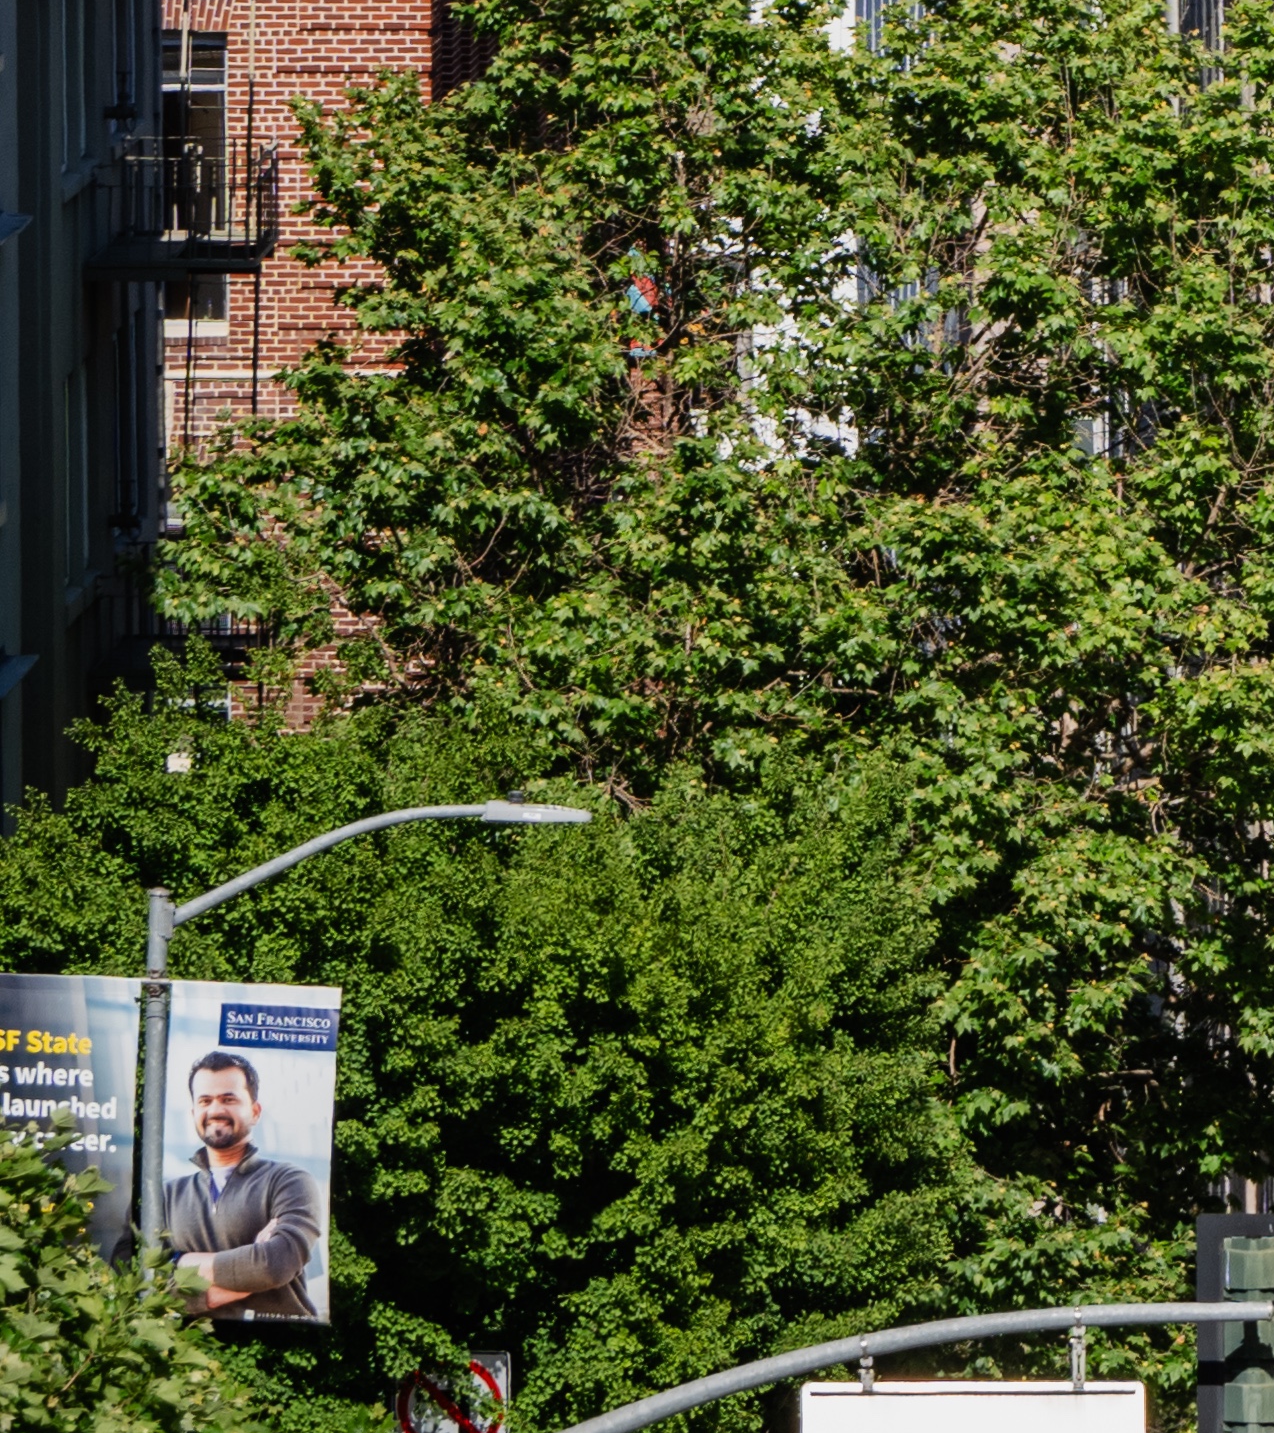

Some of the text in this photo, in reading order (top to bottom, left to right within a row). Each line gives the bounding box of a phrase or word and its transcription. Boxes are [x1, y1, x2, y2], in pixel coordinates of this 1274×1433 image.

[227, 1011, 331, 1029] SAN FRANCISCO
[26, 1030, 92, 1055] State
[225, 1028, 329, 1044] STATE UNIVERSITY
[14, 1061, 94, 1087] where
